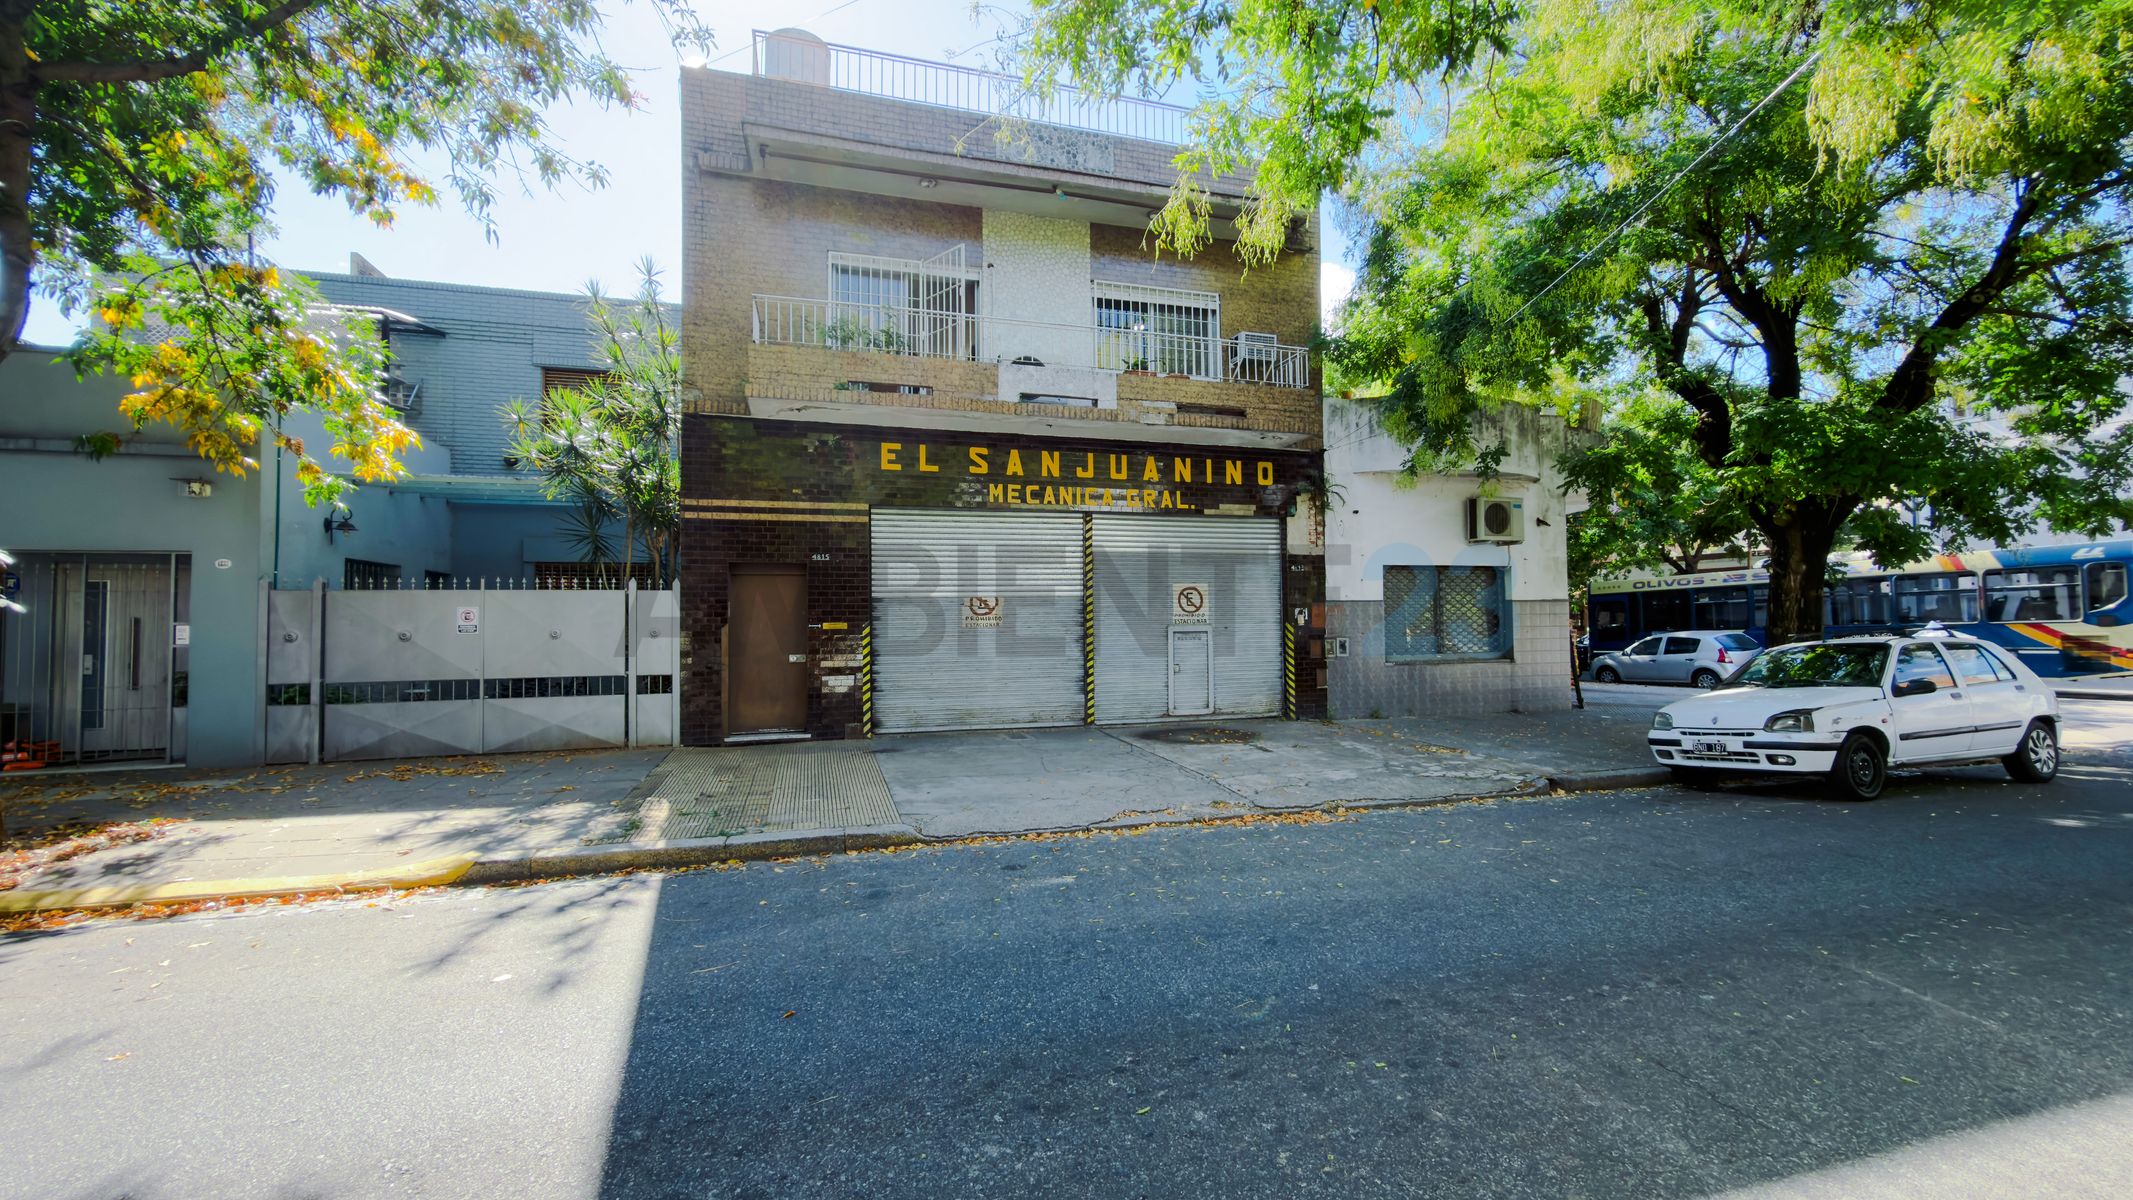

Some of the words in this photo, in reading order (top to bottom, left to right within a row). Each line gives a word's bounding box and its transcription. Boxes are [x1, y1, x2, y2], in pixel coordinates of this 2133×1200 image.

[880, 442, 940, 472] EL
[968, 446, 1274, 486] SANJUANINO
[989, 483, 1113, 506] MECANICA
[1126, 489, 1196, 509] GRAL.
[811, 553, 830, 561] 4815
[1632, 577, 1705, 590] OLIVOS
[1711, 743, 1726, 753] 187
